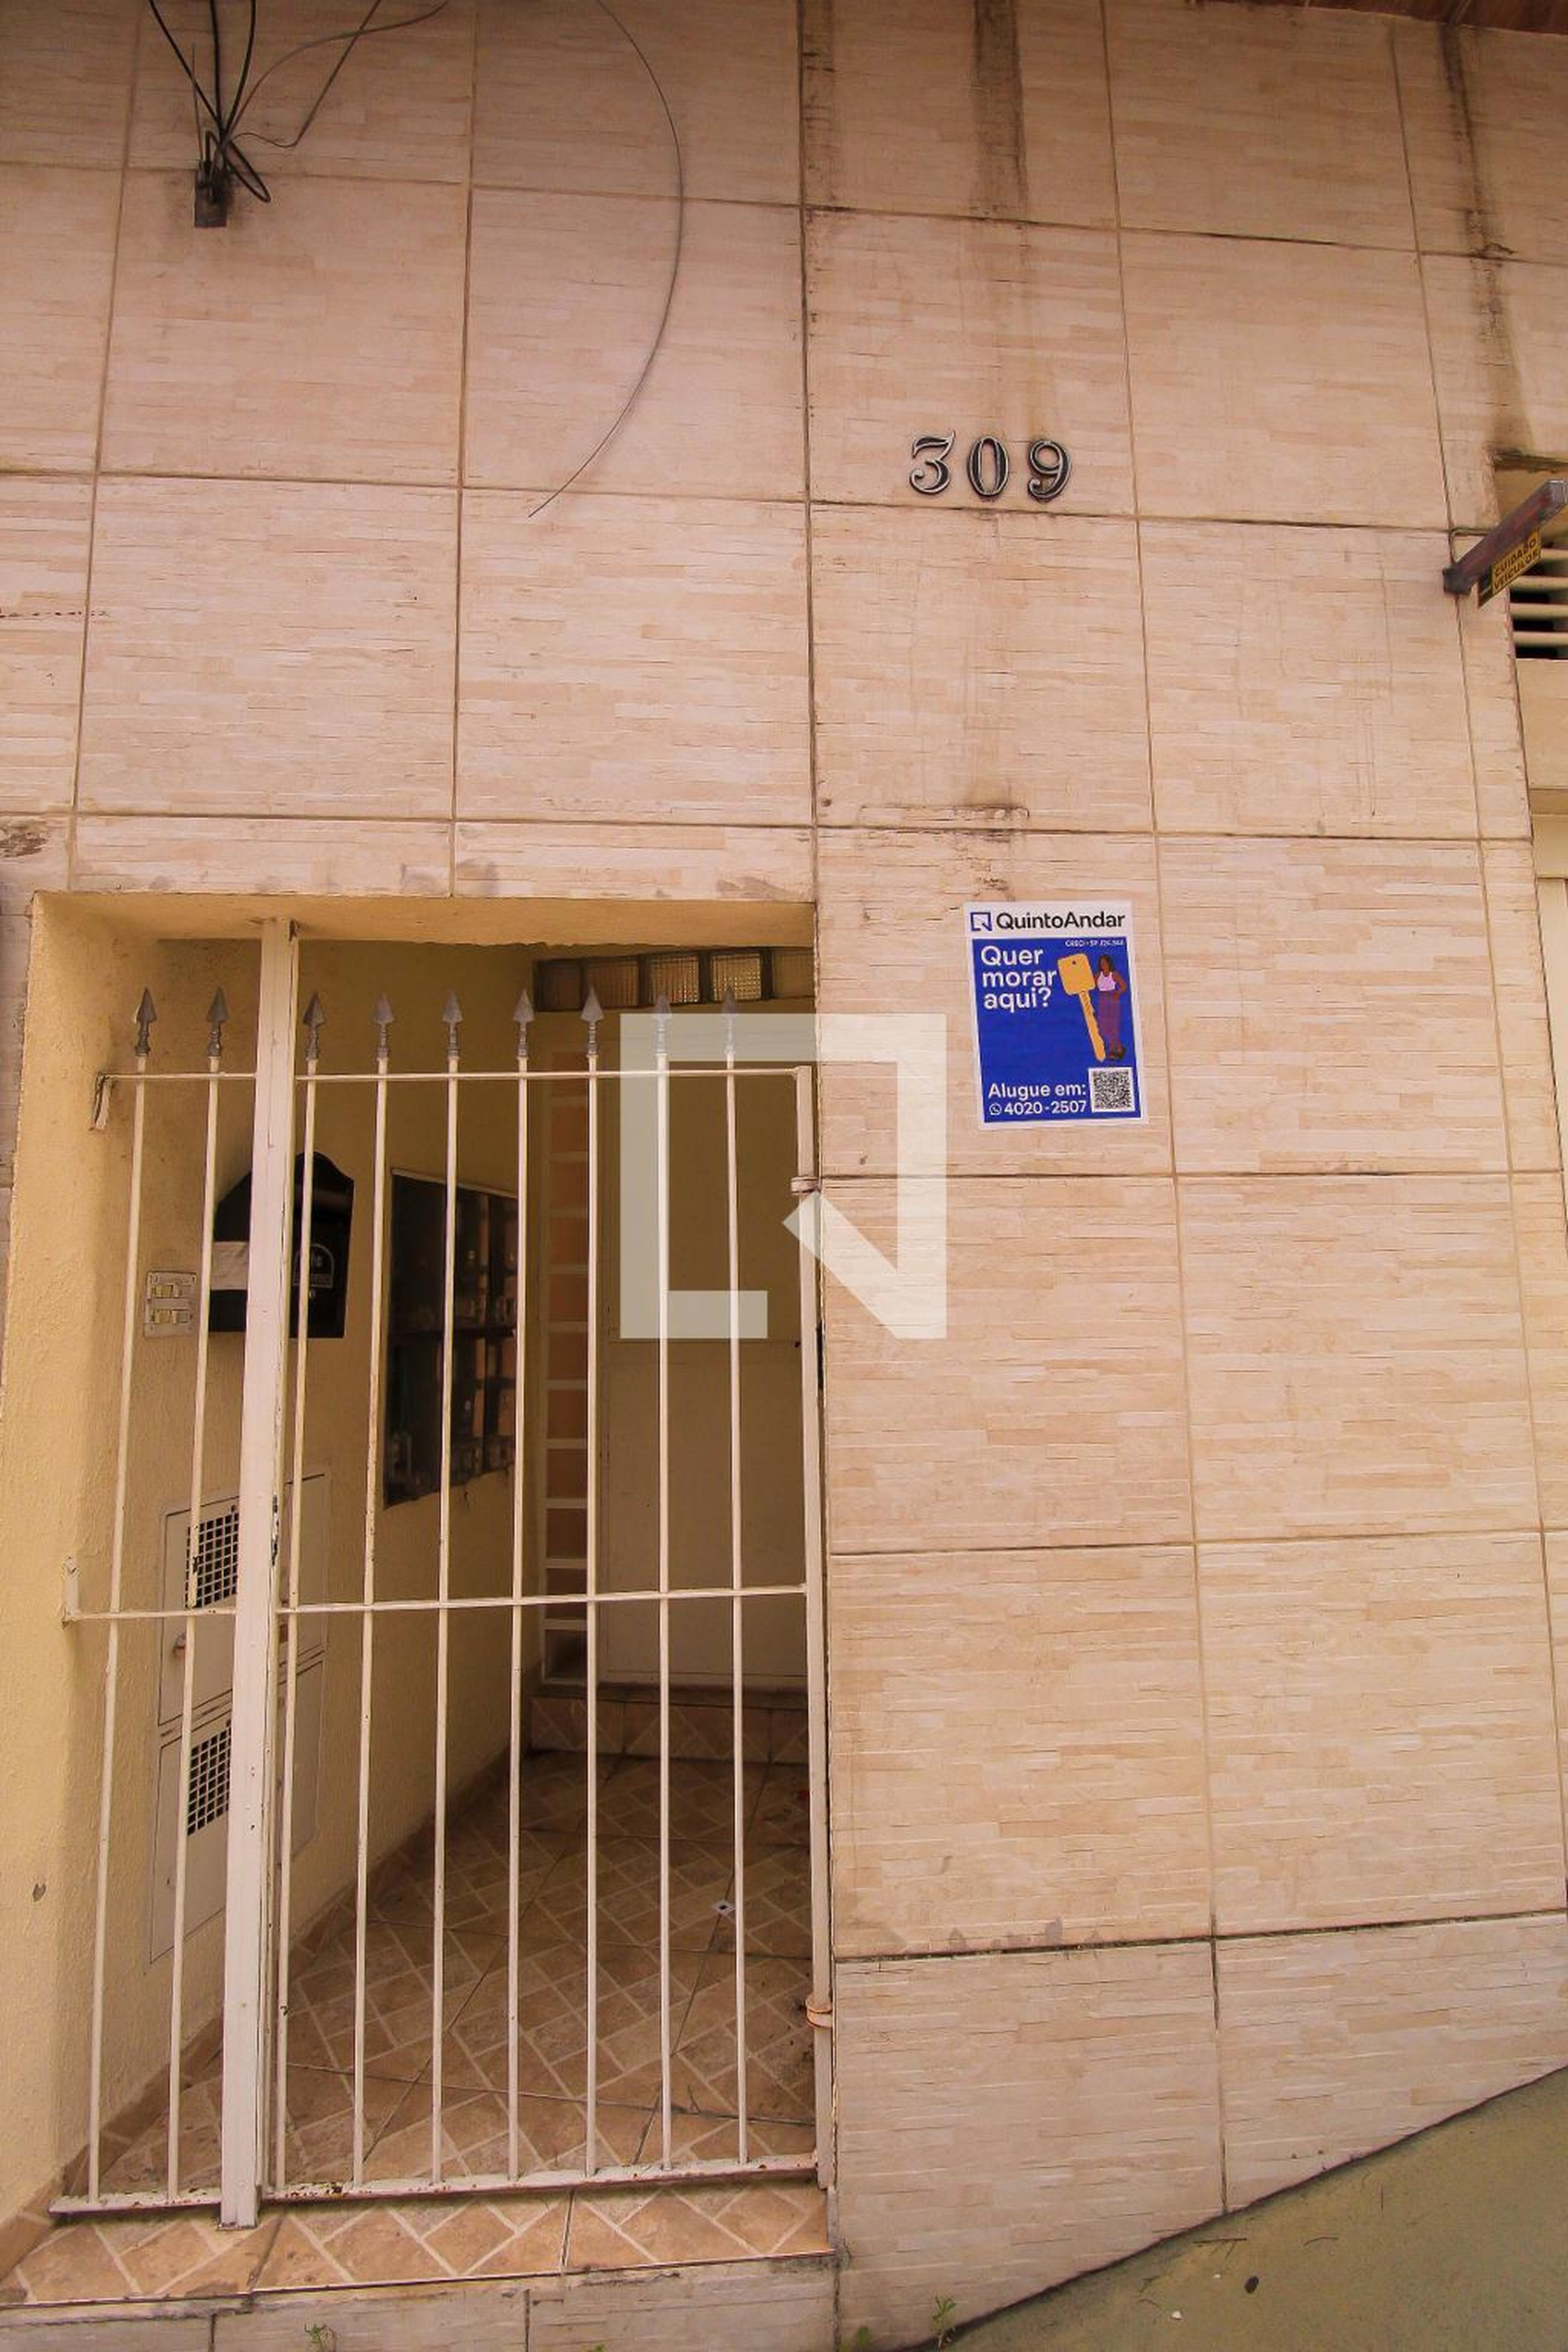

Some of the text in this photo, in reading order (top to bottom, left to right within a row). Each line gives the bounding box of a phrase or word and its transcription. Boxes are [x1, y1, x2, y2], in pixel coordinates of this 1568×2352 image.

[910, 430, 1071, 502] 309
[996, 911, 1125, 930] QuintoAndar
[981, 945, 1043, 966] Quer
[982, 970, 1057, 987] morar
[984, 987, 1051, 1013] aqui?
[988, 1083, 1086, 1101] Alugue em:
[1004, 1100, 1087, 1115] 4020-2507
